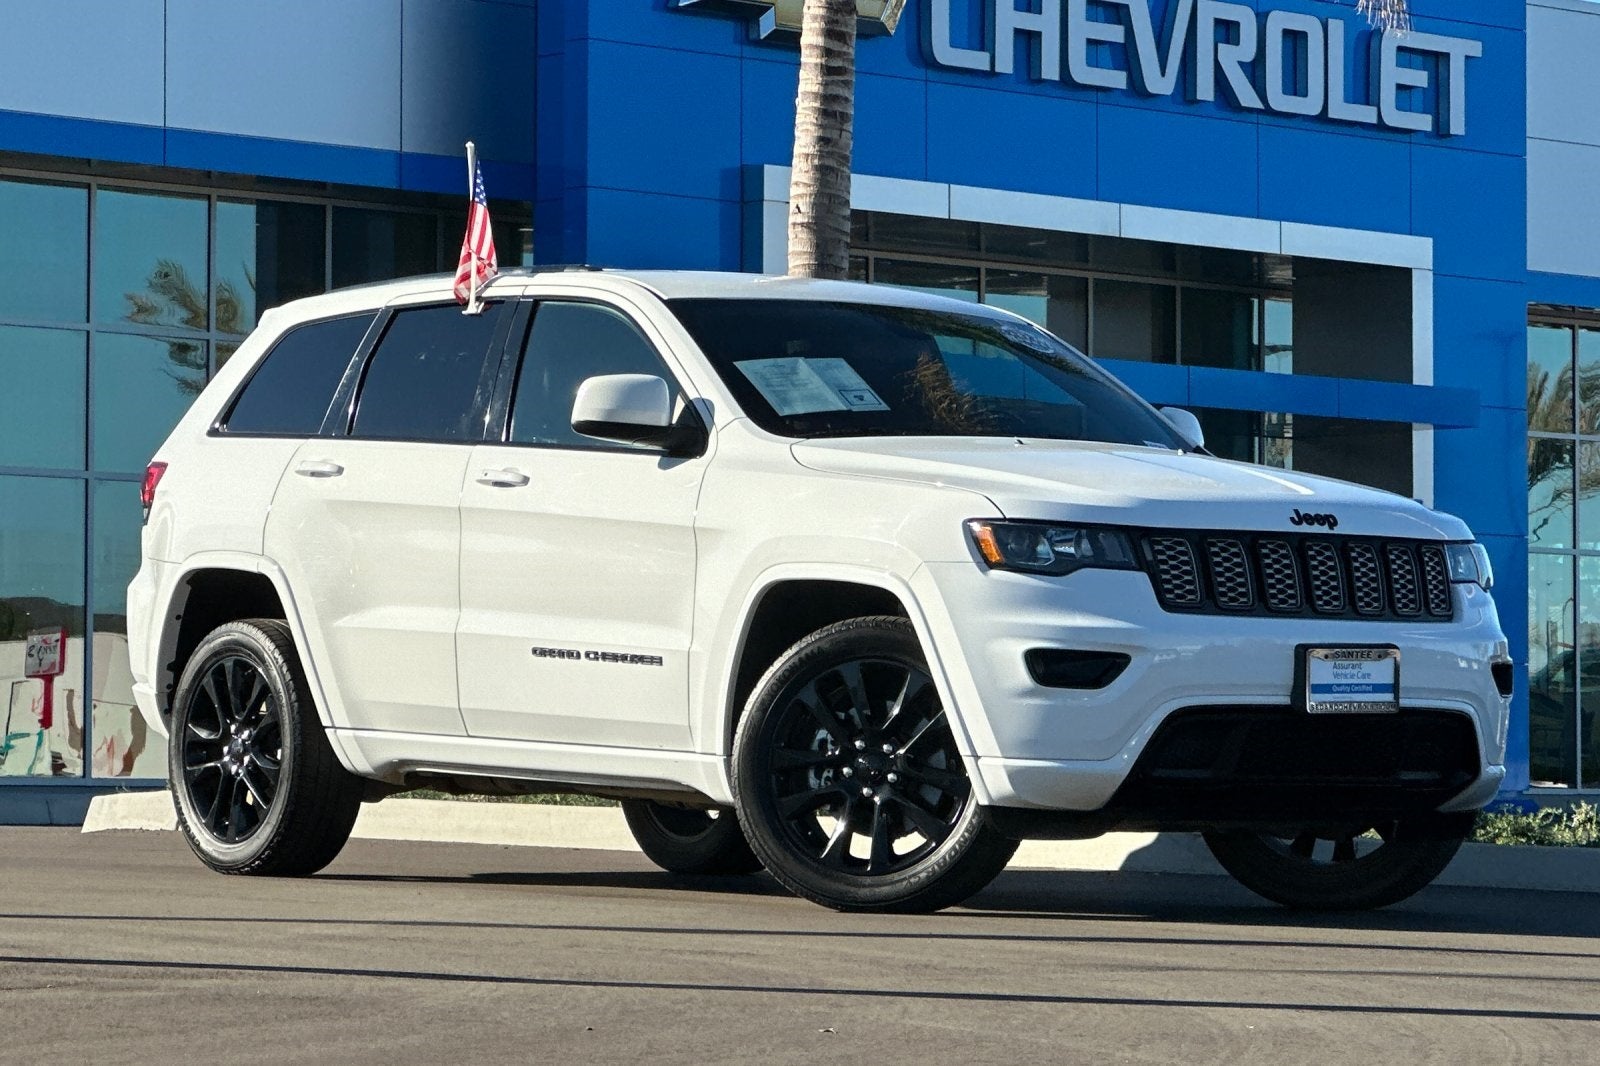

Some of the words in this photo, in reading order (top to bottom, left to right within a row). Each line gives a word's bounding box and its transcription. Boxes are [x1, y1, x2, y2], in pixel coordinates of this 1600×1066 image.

[929, 0, 1483, 136] CHEVROLET
[1289, 508, 1339, 530] Jeep
[531, 647, 581, 660] GRAND
[584, 650, 664, 666] CHEROKEE
[1334, 650, 1373, 659] SANTEE
[1333, 662, 1362, 670] Assurant
[1333, 671, 1356, 680] Vehicle
[1356, 671, 1372, 680] Care
